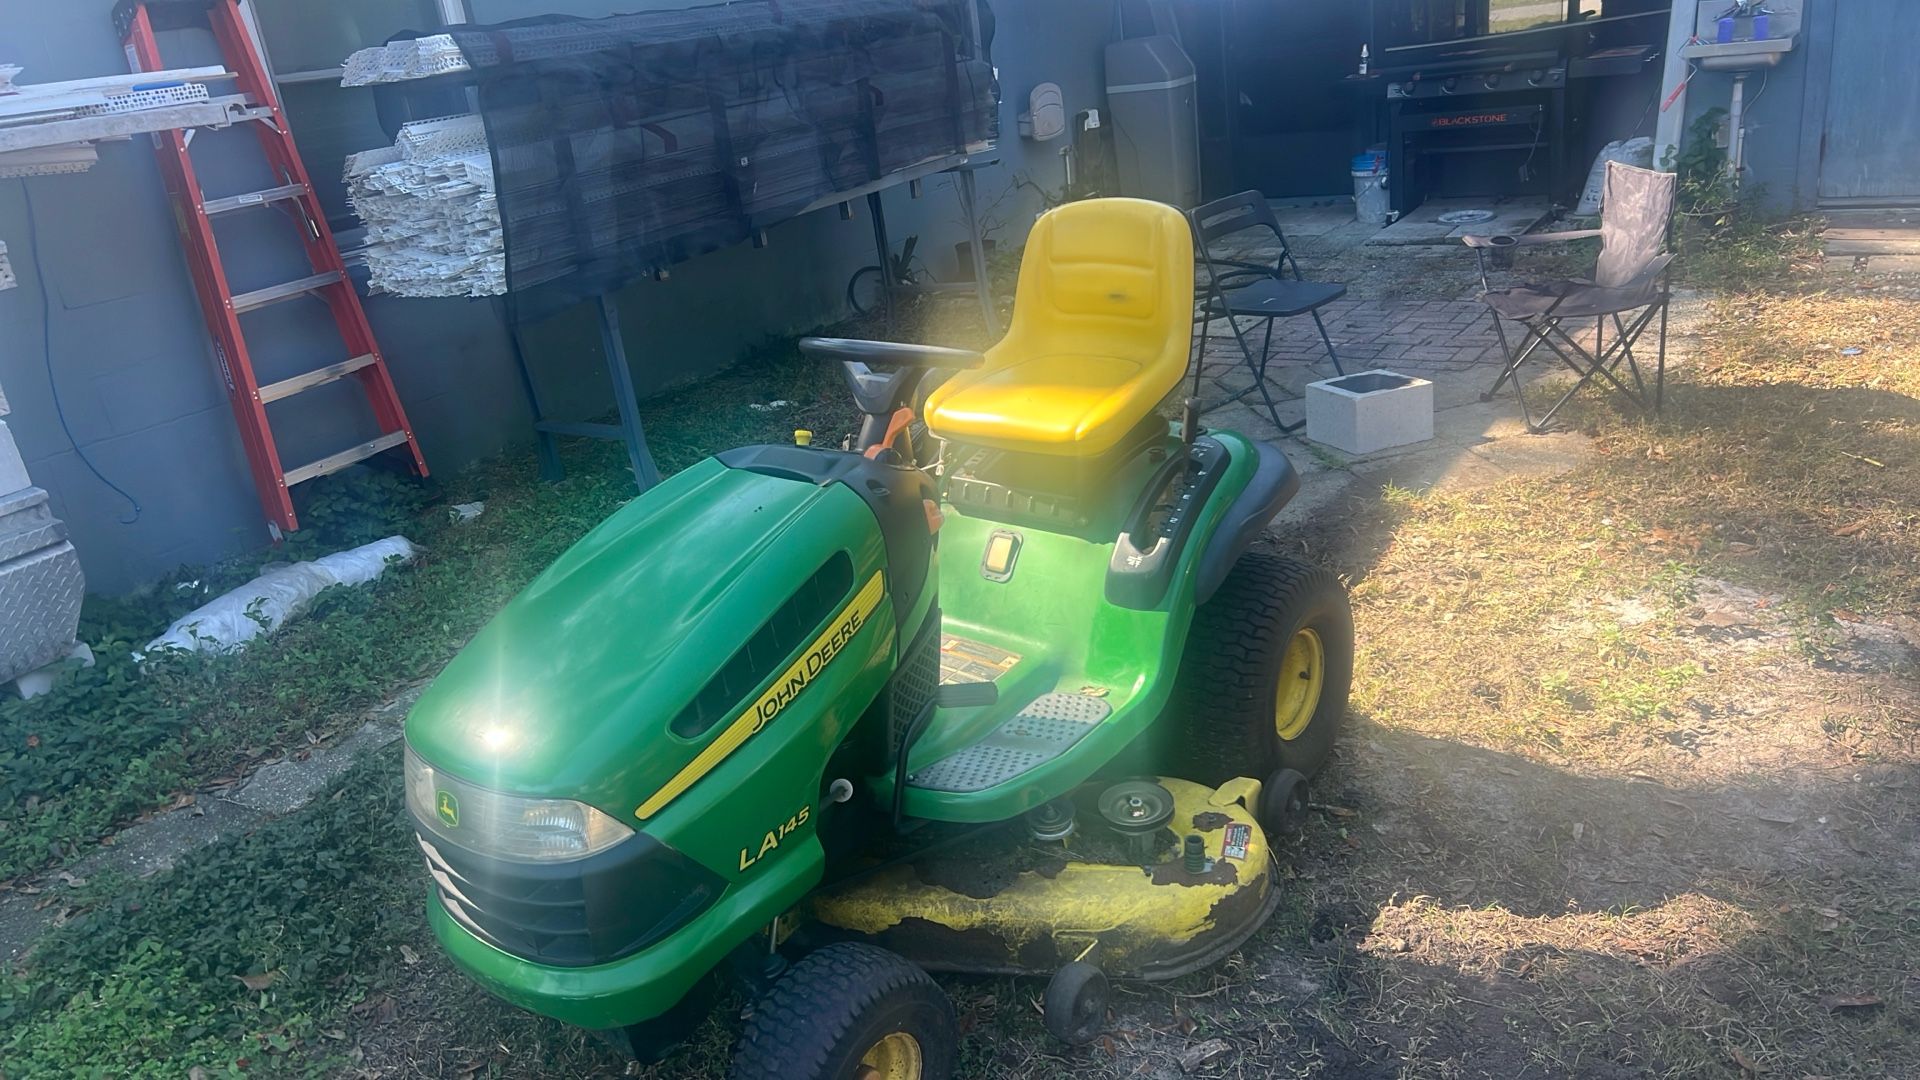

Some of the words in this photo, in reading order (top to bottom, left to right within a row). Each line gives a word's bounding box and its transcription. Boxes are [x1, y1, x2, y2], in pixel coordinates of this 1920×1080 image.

[1437, 113, 1506, 126] BLACKSTONE
[753, 671, 805, 732] JOHN
[806, 609, 860, 678] DEERE
[739, 804, 810, 872] LA145
